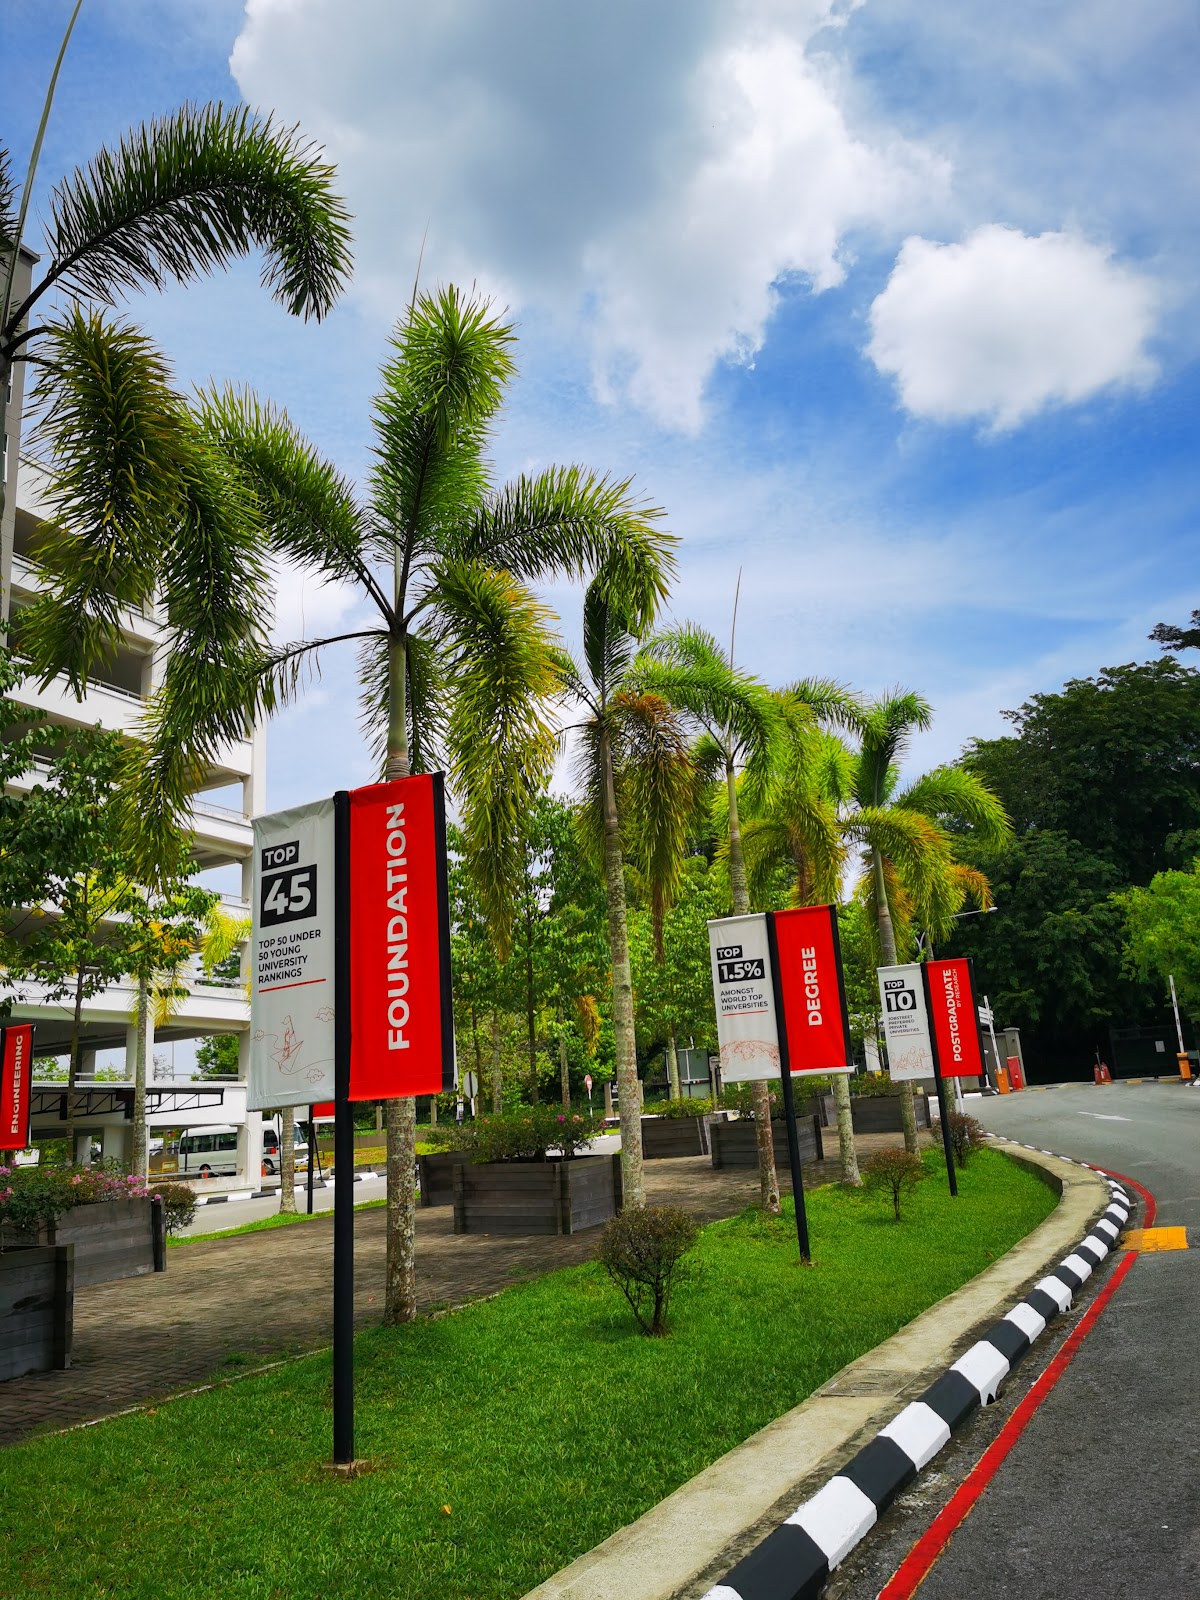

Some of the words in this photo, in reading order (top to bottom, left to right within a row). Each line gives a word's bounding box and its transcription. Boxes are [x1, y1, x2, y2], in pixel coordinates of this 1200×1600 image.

[265, 846, 296, 866] TOP
[263, 872, 311, 915] 45
[386, 802, 409, 1051] FOUNDATION
[259, 939, 276, 949] TOP
[277, 936, 288, 946] 50
[289, 929, 321, 944] UNDER
[258, 951, 269, 960] 50
[270, 945, 301, 959] YOUNG
[718, 948, 740, 958] TOP
[258, 955, 308, 972] UNIVERSITY
[721, 961, 762, 980] 1.5%
[258, 967, 302, 984] RANKINGS
[952, 969, 961, 999] RESEARCH
[720, 987, 754, 996] AMONGST
[801, 946, 823, 1026] DEGREE
[721, 995, 747, 1004] WORLD
[722, 1001, 768, 1011] UNIVERSITIES
[887, 992, 913, 1011] 10
[957, 1000, 962, 1008] BY
[943, 969, 962, 1062] POSTGRADUATE
[11, 1035, 23, 1134] ENGINEERING
